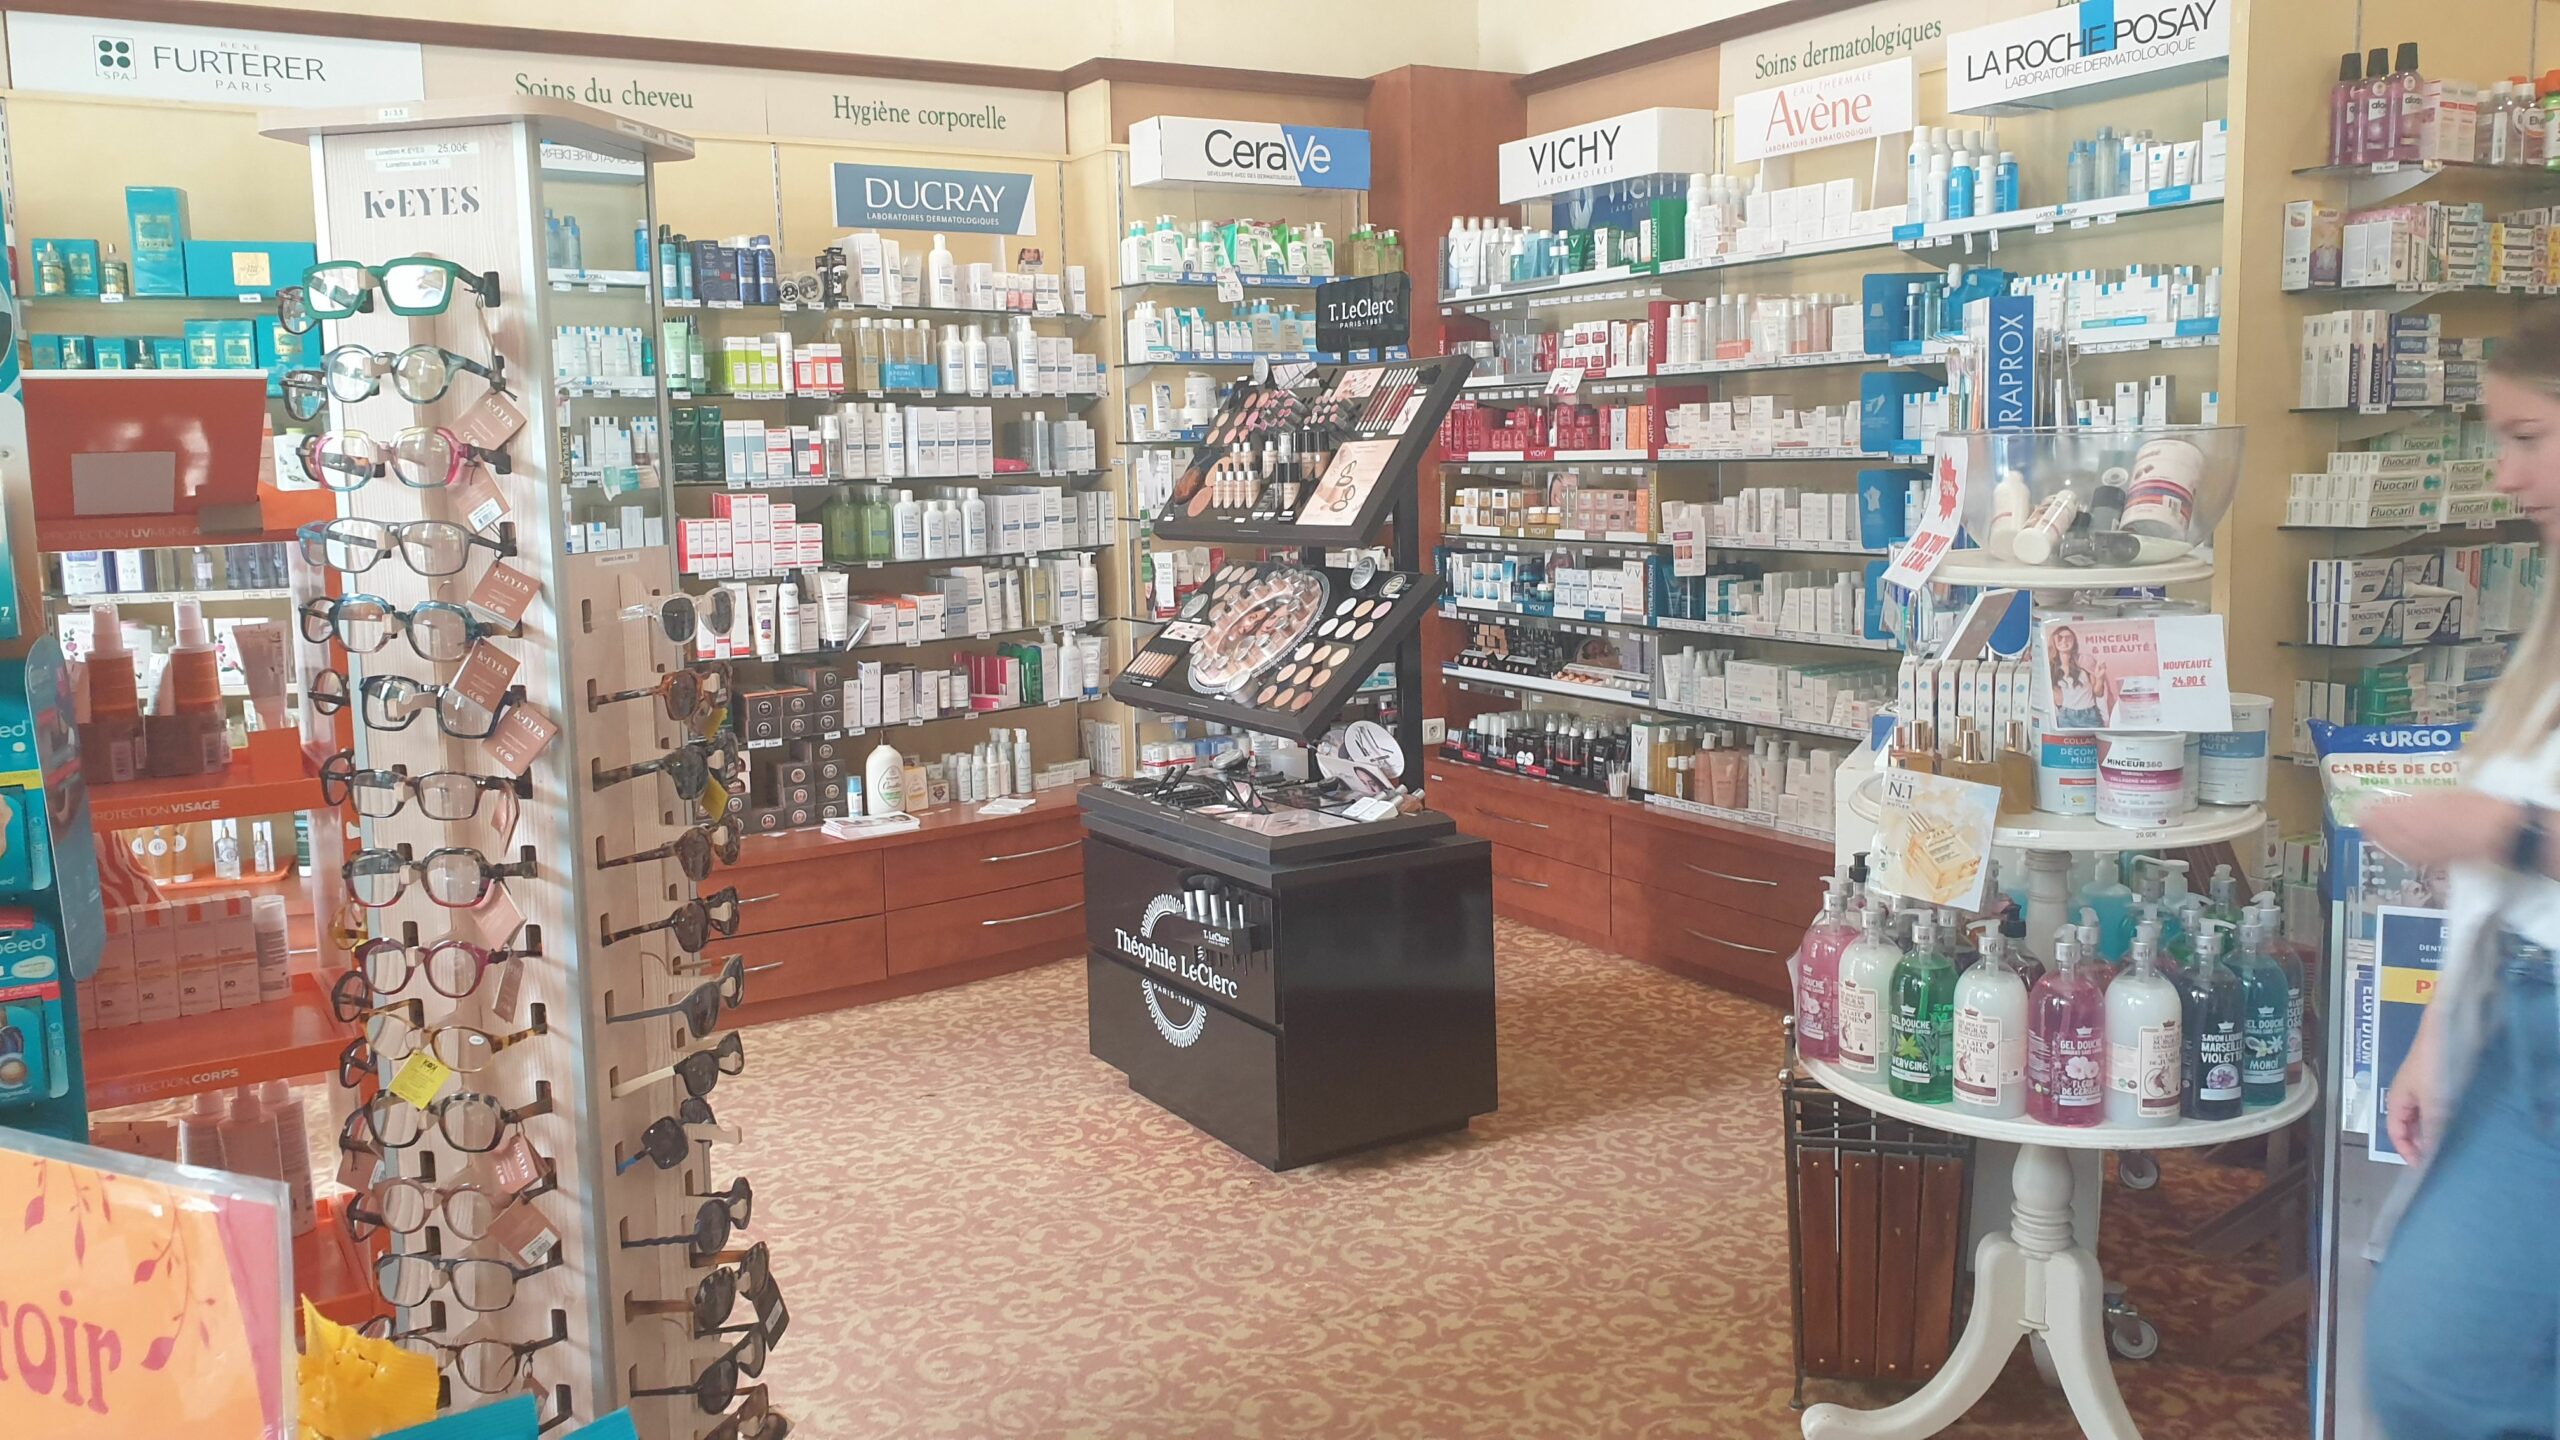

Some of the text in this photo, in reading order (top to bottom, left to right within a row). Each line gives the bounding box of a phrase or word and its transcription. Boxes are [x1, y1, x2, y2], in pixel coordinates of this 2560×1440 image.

[1967, 0, 2217, 82] LA ROCHE POSAY
[1754, 18, 1942, 80] Soins dermatologiques
[153, 45, 326, 82] FURTERER
[2005, 36, 2197, 89] LABORATOIRE DERMATOLOGIQUE
[103, 70, 130, 81] SPA
[215, 79, 272, 93] PARIS
[515, 72, 693, 110] Soins du cheveu
[1792, 71, 1873, 98] EAU THERMALE
[833, 95, 1007, 131] Hygiène corporelle
[1765, 90, 1873, 143] Avène
[1765, 126, 1873, 154] LABORATOIRE DERMATOLOGIQUE
[1204, 129, 1331, 174] CeraVe
[1529, 125, 1621, 176] VICHY
[1536, 164, 1615, 188] LABORATOIRES
[864, 177, 1007, 214] DUCRAY
[1611, 197, 1650, 213] LABORAT
[866, 211, 1000, 226] LABORATOIRES DERMATOLOGIQUES
[1341, 298, 1395, 321] LeClerc
[1998, 313, 2024, 429] RAPROX
[2350, 352, 2359, 403] ELGYDIUM
[2403, 439, 2440, 449] Fluocaril
[2381, 456, 2421, 467] Fluocaril
[2372, 479, 2419, 491] Fluocaril
[2370, 505, 2416, 517] Fluocaril
[2449, 502, 2489, 514] Fluocaril
[1530, 527, 1547, 535] VICHY
[1529, 603, 1546, 611] VICHY
[2085, 633, 2140, 644] MINCEUR
[2102, 642, 2150, 654] BEAUTÉ
[2162, 657, 2213, 671] NOUVEAUTÉ
[2379, 730, 2452, 748] URGO
[2330, 760, 2462, 775] CARRÉS DE COT
[170, 799, 221, 814] VISAGE
[1114, 927, 1238, 999] Théophile LeClerc
[1901, 1018, 1931, 1030] DOUCHE
[2060, 1040, 2075, 1050] GEL
[2201, 1033, 2225, 1042] SAVON
[2201, 1041, 2243, 1052] MARSEILL
[2201, 1052, 2242, 1064] VIOLETT
[191, 1067, 240, 1085] CORPS
